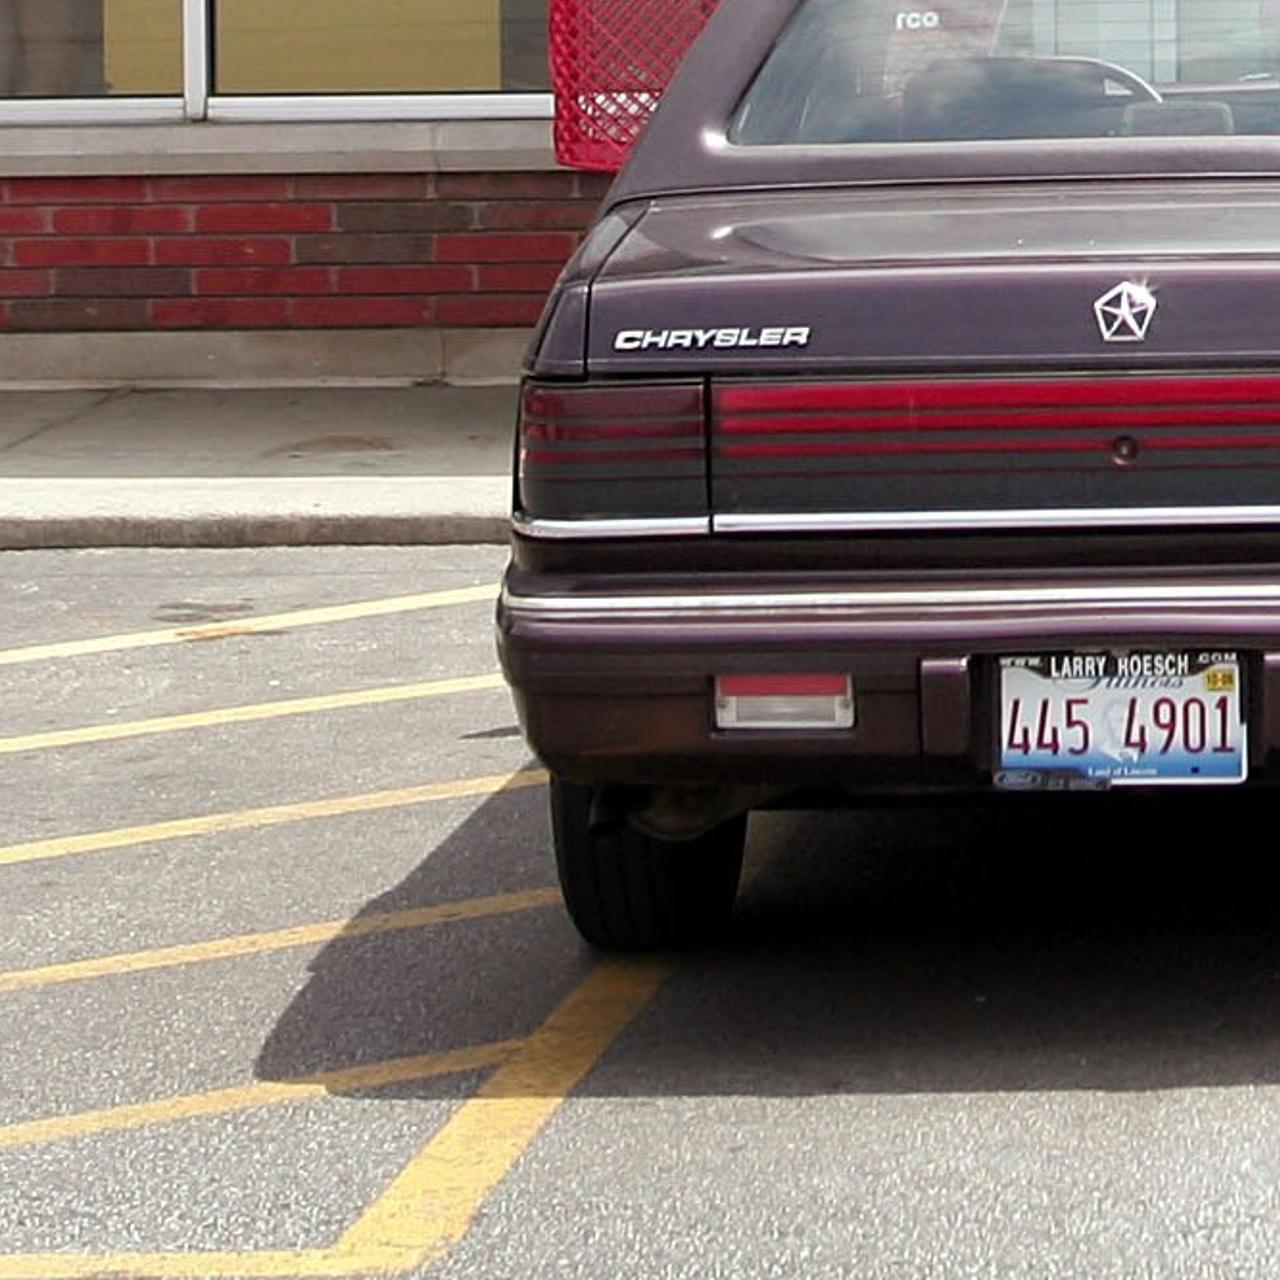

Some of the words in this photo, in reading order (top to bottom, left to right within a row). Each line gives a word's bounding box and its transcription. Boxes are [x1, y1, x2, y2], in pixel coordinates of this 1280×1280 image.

[613, 325, 810, 350] CHRYSLER
[1050, 654, 1107, 678] LARRY
[1007, 698, 1090, 756] 445
[1124, 695, 1236, 756] 4901
